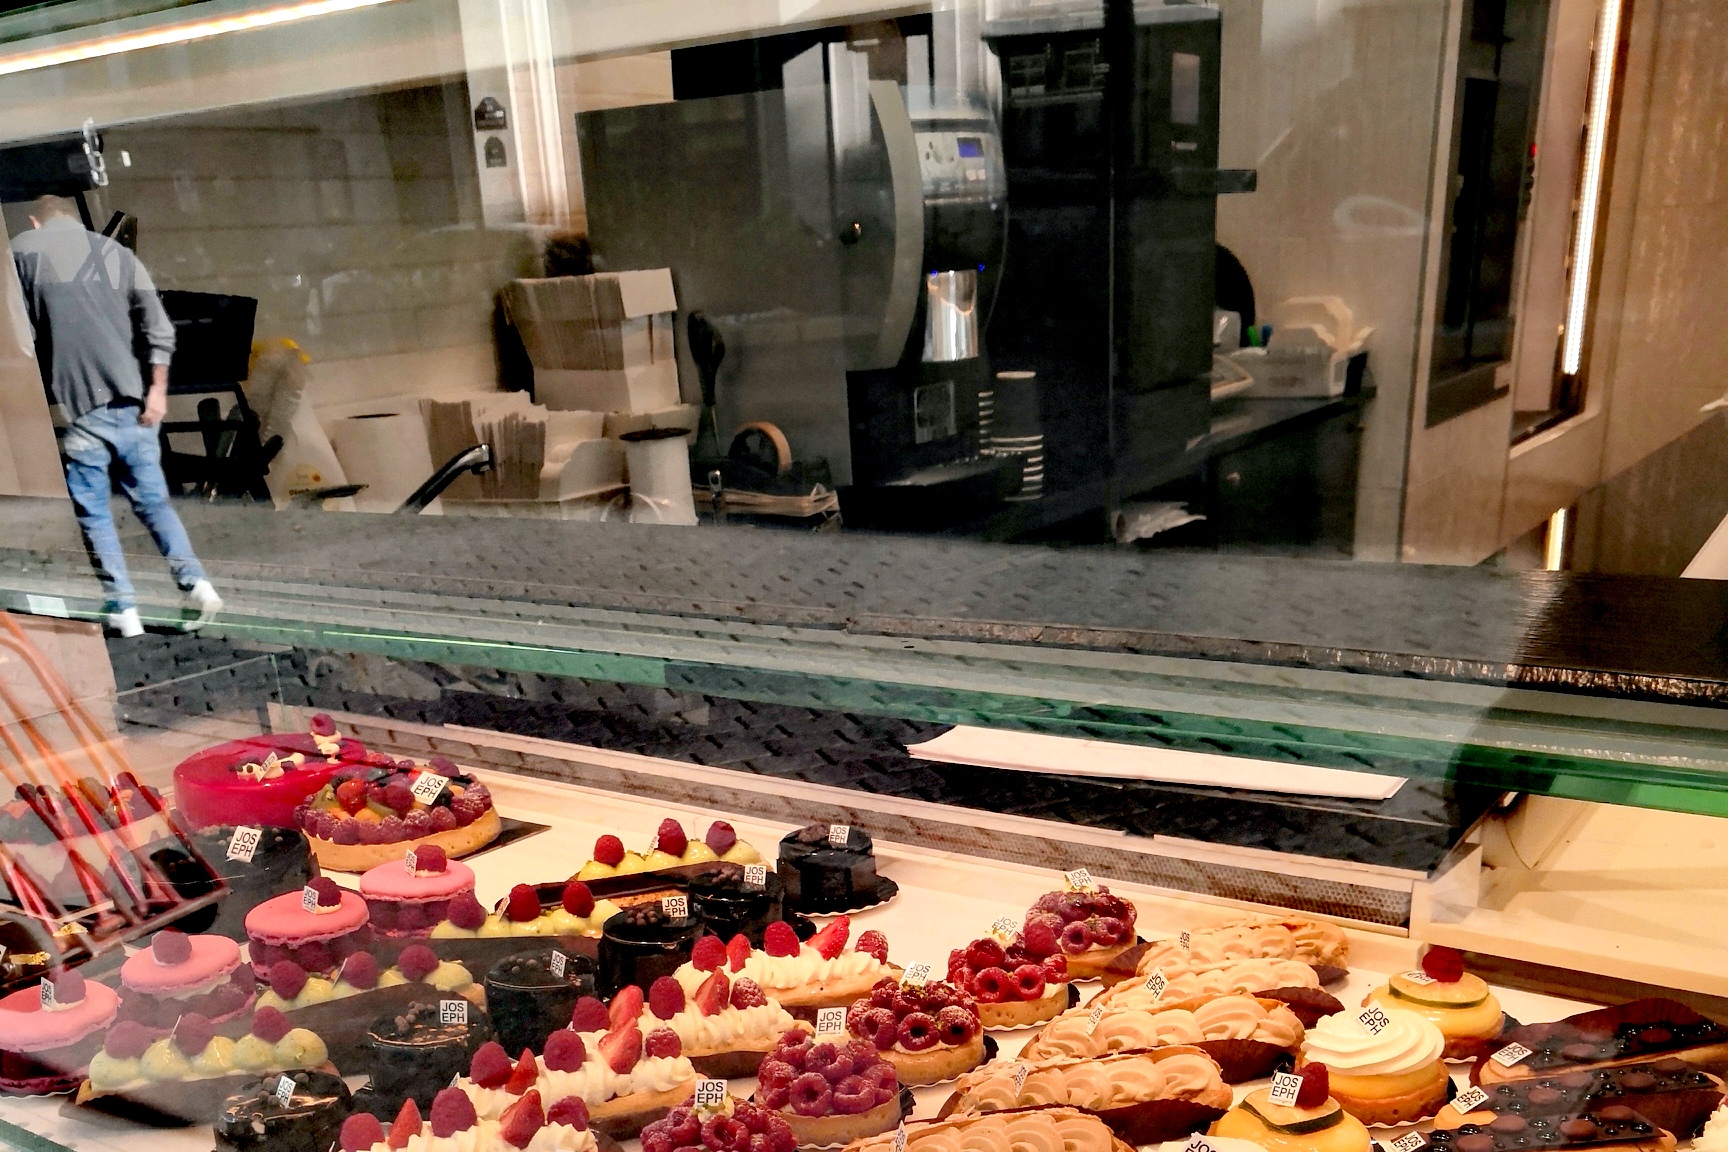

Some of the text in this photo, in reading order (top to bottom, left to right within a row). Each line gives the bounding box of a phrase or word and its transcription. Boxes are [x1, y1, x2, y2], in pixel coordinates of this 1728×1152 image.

[421, 777, 443, 788] JOS
[414, 786, 436, 797] EPH
[236, 832, 257, 844] JOS
[231, 843, 252, 857] EPH
[746, 867, 763, 875] JOS
[1070, 870, 1087, 880] JOS
[746, 876, 765, 884] EPH
[1074, 877, 1091, 887] EPH
[305, 889, 316, 899] JOS
[304, 898, 315, 908] EPH
[665, 898, 684, 908] JOS
[997, 917, 1018, 928] JOS
[992, 922, 1013, 935] EPH
[553, 953, 564, 965] JOS
[910, 964, 930, 973] JOS
[905, 971, 927, 981] EPH
[1152, 974, 1165, 990] JOS
[42, 982, 51, 994] JOS
[1146, 979, 1160, 998] EPH
[42, 991, 51, 1001] EPH
[442, 1002, 464, 1011] JOS
[442, 1013, 464, 1022] EPH
[820, 1011, 841, 1021] JOS
[1369, 1008, 1389, 1027] JOS
[819, 1022, 841, 1031] EPH
[1359, 1013, 1381, 1035] EPH
[1498, 1049, 1518, 1060] EPH
[1508, 1044, 1527, 1055] JOS
[698, 1082, 723, 1092] JOS
[1276, 1076, 1298, 1087] JOS
[697, 1093, 723, 1103] EPH
[1272, 1086, 1295, 1099] EPH
[1467, 1089, 1484, 1101] JOS
[1457, 1094, 1474, 1108] EPH
[1405, 1134, 1421, 1147] JOS
